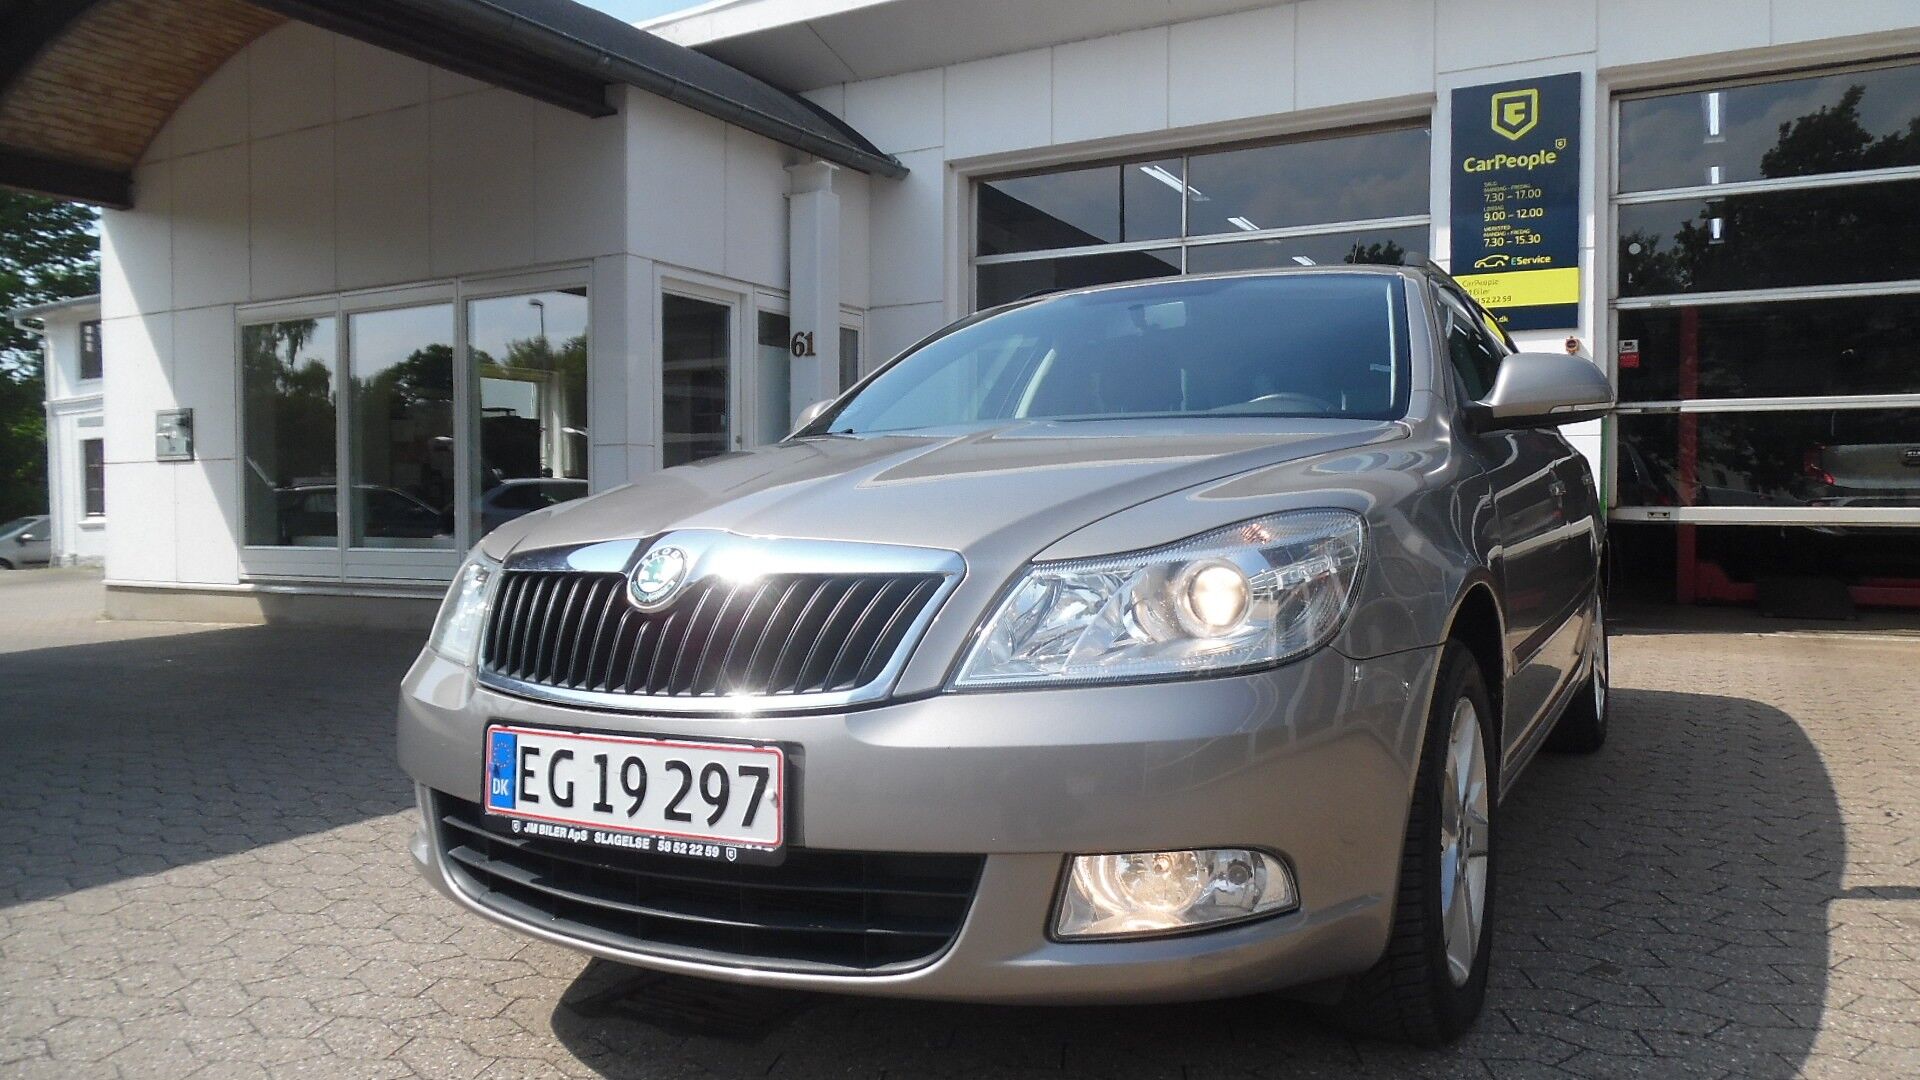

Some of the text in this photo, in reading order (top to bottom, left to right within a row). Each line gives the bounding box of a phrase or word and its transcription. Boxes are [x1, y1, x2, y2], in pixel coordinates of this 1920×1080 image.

[1463, 149, 1557, 172] CarPeople
[1484, 192, 1504, 202] 7.30
[1515, 188, 1541, 200] 17.00
[1484, 211, 1506, 222] 9.00
[1516, 207, 1543, 218] 12.00
[1484, 237, 1504, 247] 7.30
[1515, 233, 1541, 244] 15.30
[791, 331, 816, 357] 61
[492, 777, 509, 796] DK
[519, 746, 770, 827] EG 19 297
[524, 822, 539, 834] JM
[538, 824, 567, 839] BILER
[567, 826, 588, 842] ApS
[594, 832, 650, 850] SLAGELSE
[673, 841, 687, 854] 52
[689, 843, 703, 856] 22
[704, 845, 720, 858] 59
